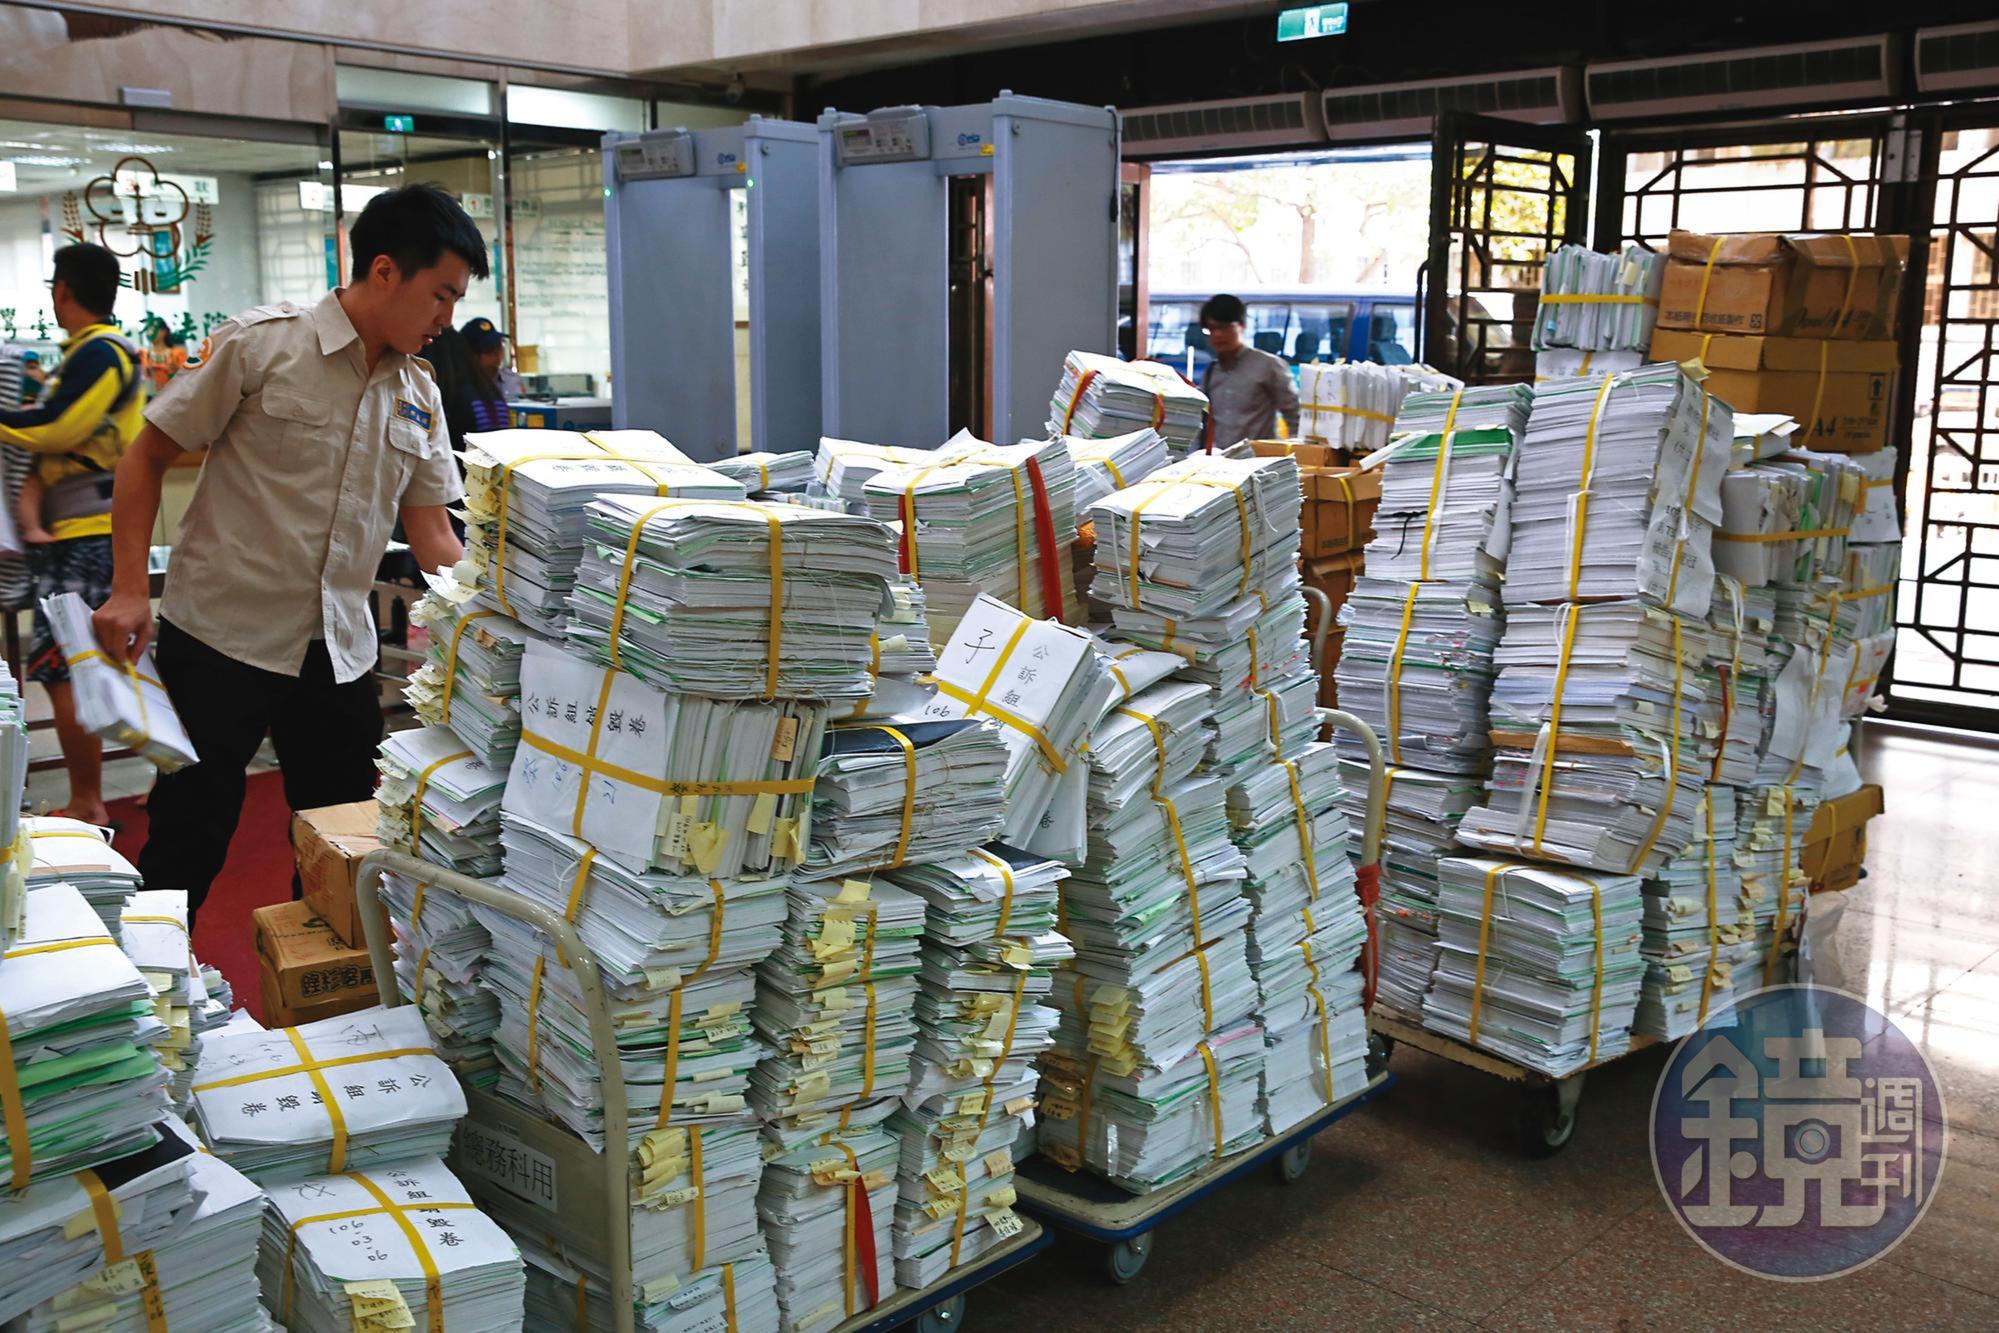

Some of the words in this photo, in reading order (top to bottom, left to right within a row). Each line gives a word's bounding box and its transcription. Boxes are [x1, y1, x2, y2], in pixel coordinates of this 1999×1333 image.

[964, 629, 996, 664] 子
[924, 705, 951, 717] 106
[386, 1170, 465, 1248] 公訴組毀卷
[328, 1220, 365, 1235] 106
[367, 1249, 389, 1262] 06
